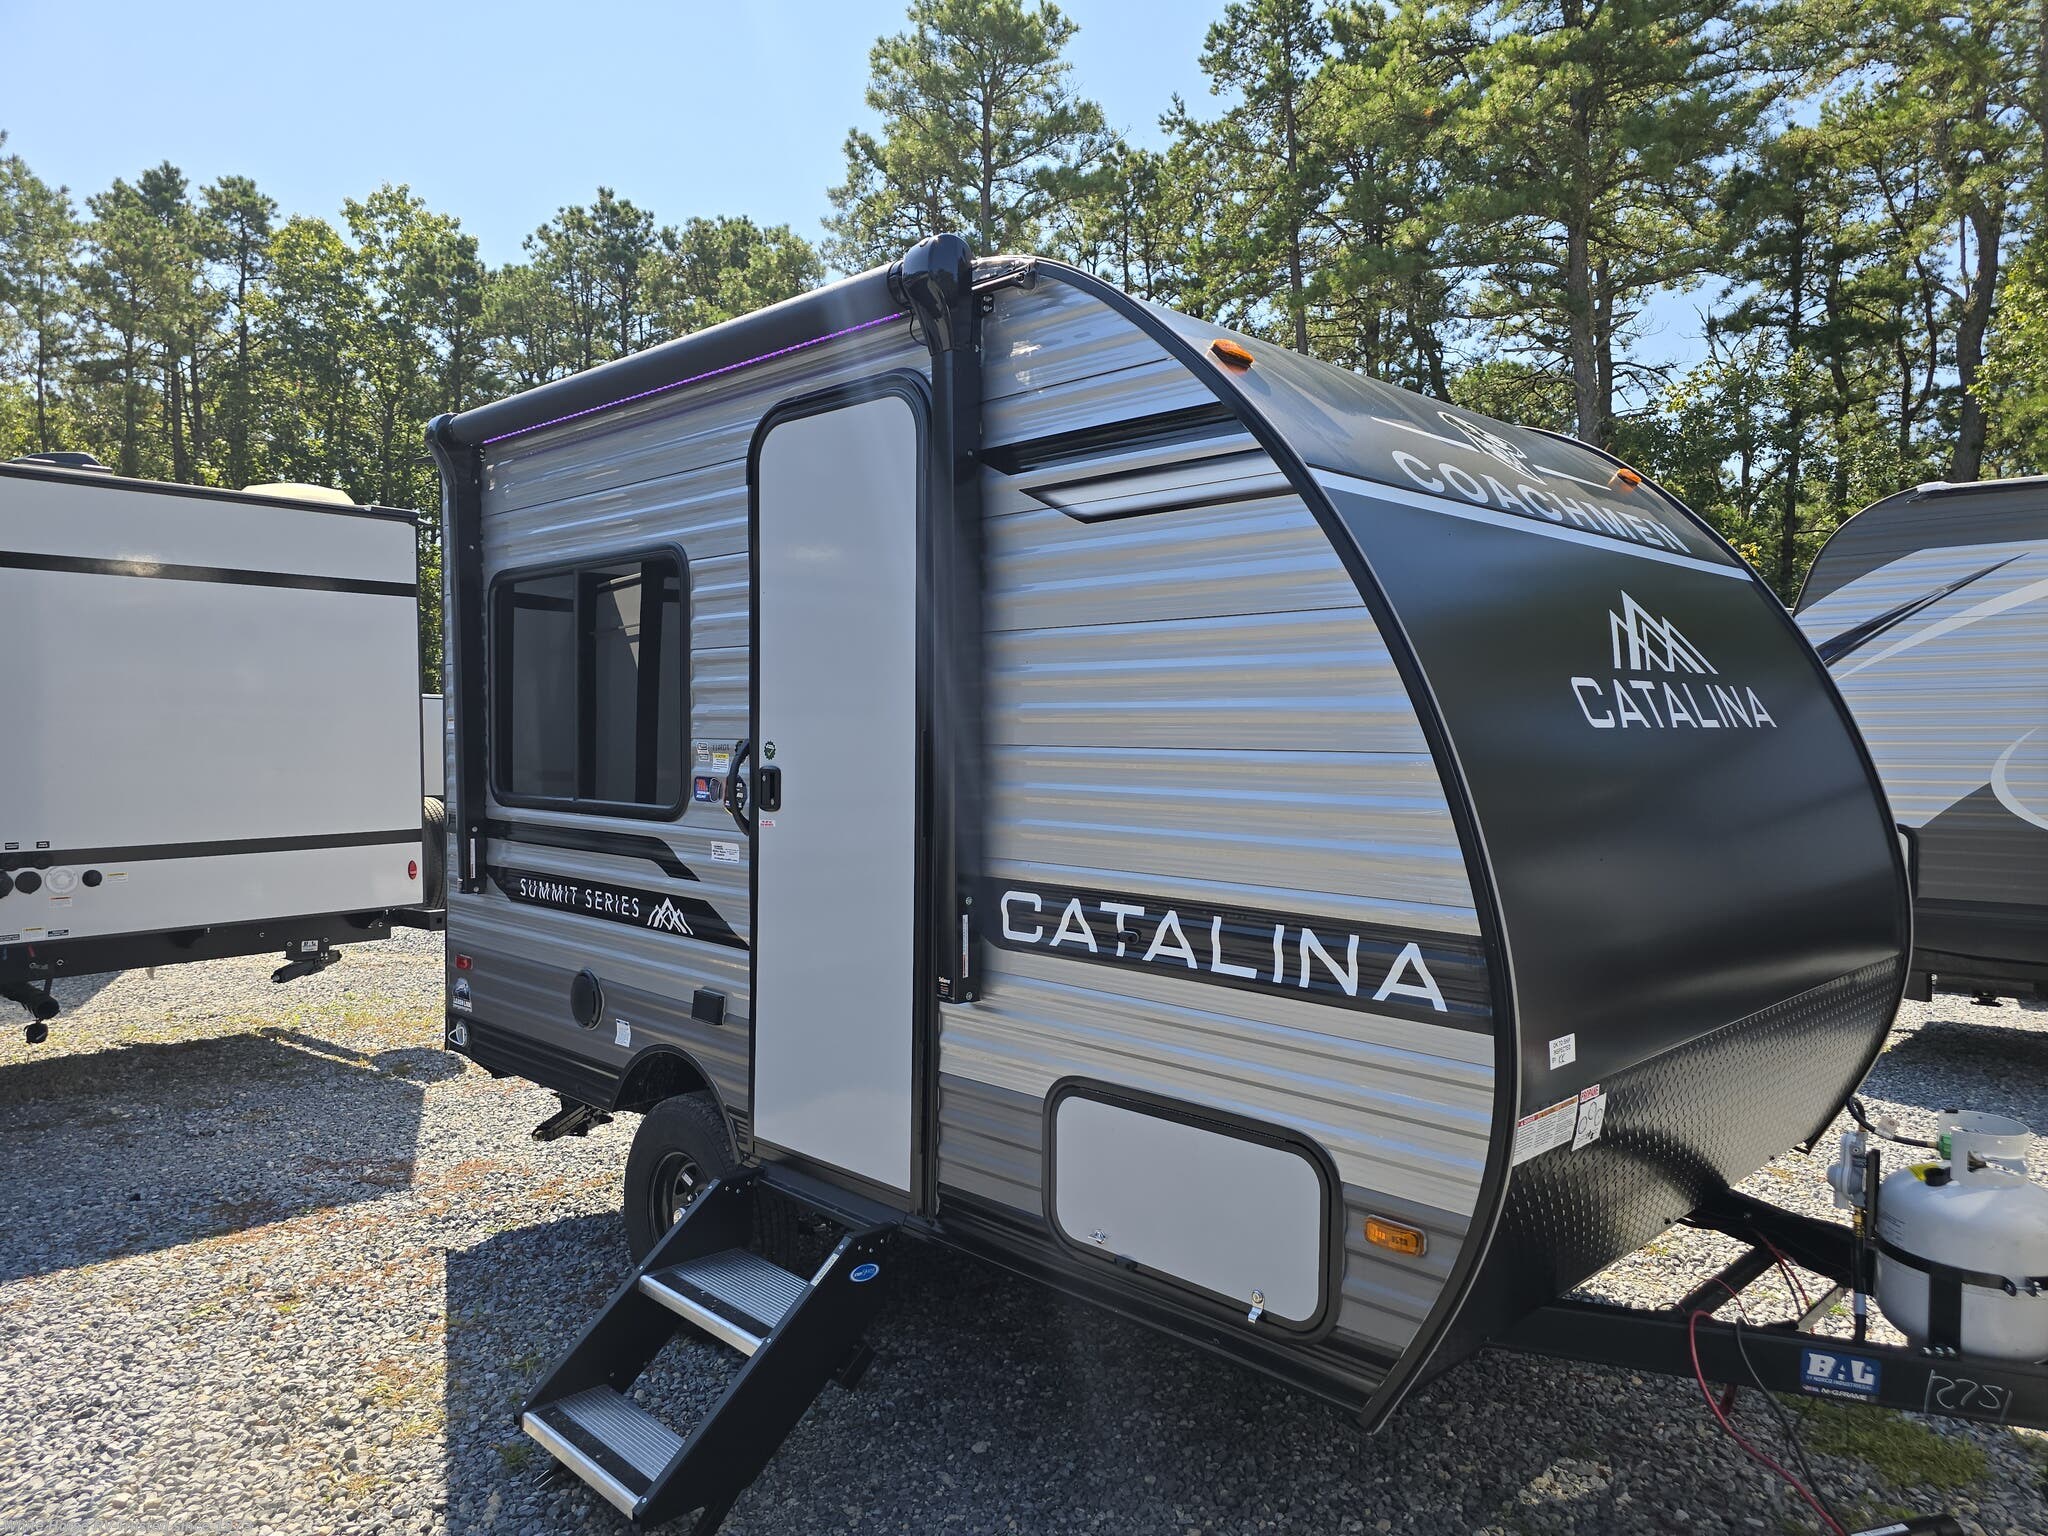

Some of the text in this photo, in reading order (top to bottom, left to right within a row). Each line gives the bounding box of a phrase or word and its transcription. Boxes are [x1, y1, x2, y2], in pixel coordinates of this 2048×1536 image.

[1392, 450, 1691, 554] COACHMEN
[1571, 677, 1777, 728] CATALINA
[520, 878, 640, 918] SUMMIT SERIES
[1000, 890, 1448, 1012] CATALINA
[1807, 1353, 1875, 1386] BAL
